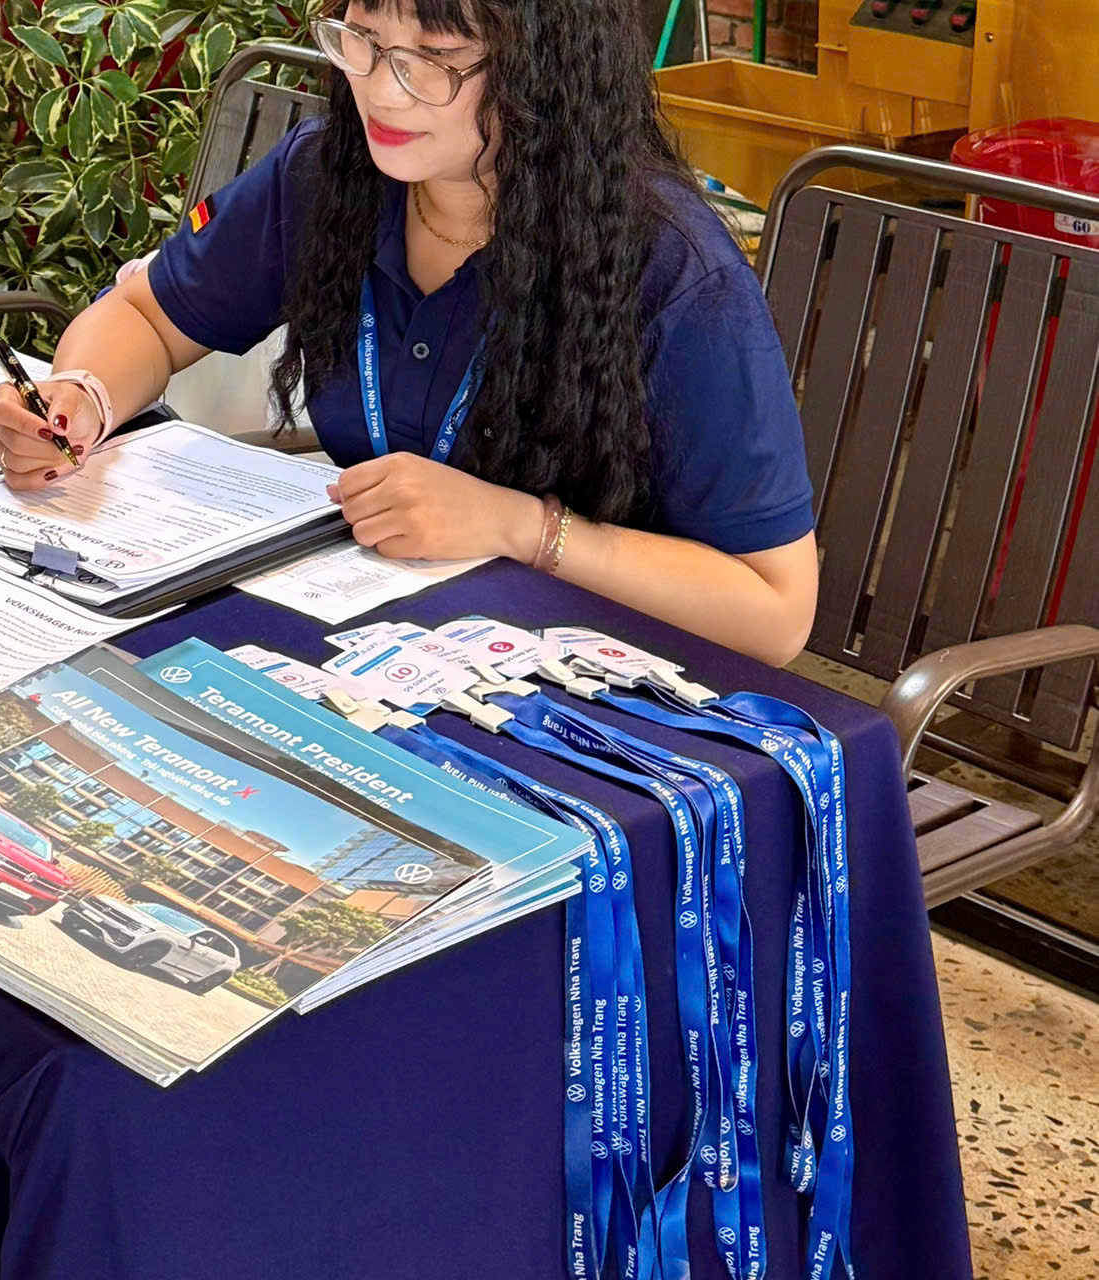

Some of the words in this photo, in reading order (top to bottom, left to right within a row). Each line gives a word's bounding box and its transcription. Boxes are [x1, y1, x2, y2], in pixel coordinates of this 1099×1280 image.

[1073, 220, 1091, 233] 60
[364, 332, 374, 389] Volkswagen
[367, 389, 377, 408] Nha
[369, 410, 381, 439] Trang
[4, 596, 76, 632] VOLKSWAGEN
[392, 667, 412, 680] 01
[52, 689, 93, 710] All
[83, 705, 137, 739] New
[133, 734, 238, 791] Teramont
[198, 685, 303, 747] Teramont
[300, 742, 414, 804] President
[542, 714, 569, 740] Trang
[570, 733, 591, 751] Nha
[830, 739, 840, 774] Trang
[650, 781, 679, 809] Trang
[831, 775, 842, 800] Nha
[580, 804, 622, 866] Volkswagen
[676, 809, 690, 837] Nha
[835, 800, 845, 871] Volkswagen
[681, 837, 696, 905] Volkswagen
[569, 937, 582, 973] Trang
[793, 926, 805, 950] Nha
[570, 974, 582, 1001] Nha
[791, 951, 806, 1016] Volkswagen
[592, 998, 607, 1033] Trang
[617, 995, 629, 1028] Trang
[736, 989, 748, 1022] Trang
[569, 1001, 584, 1077] Volkswagen
[591, 1033, 604, 1058] Nha
[688, 1029, 699, 1063] Trang
[736, 1023, 747, 1048] Nha
[837, 1025, 846, 1050] Nha
[691, 1065, 701, 1090] Nha
[736, 1048, 751, 1115] Volkswagen
[834, 1050, 847, 1120] Volkswagen
[592, 1058, 606, 1134] Volkswagen
[572, 1212, 585, 1253] Trang
[748, 1225, 761, 1259] Trang
[813, 1230, 832, 1261] Trang
[573, 1253, 587, 1276] Nha
[625, 1244, 637, 1279] Trang
